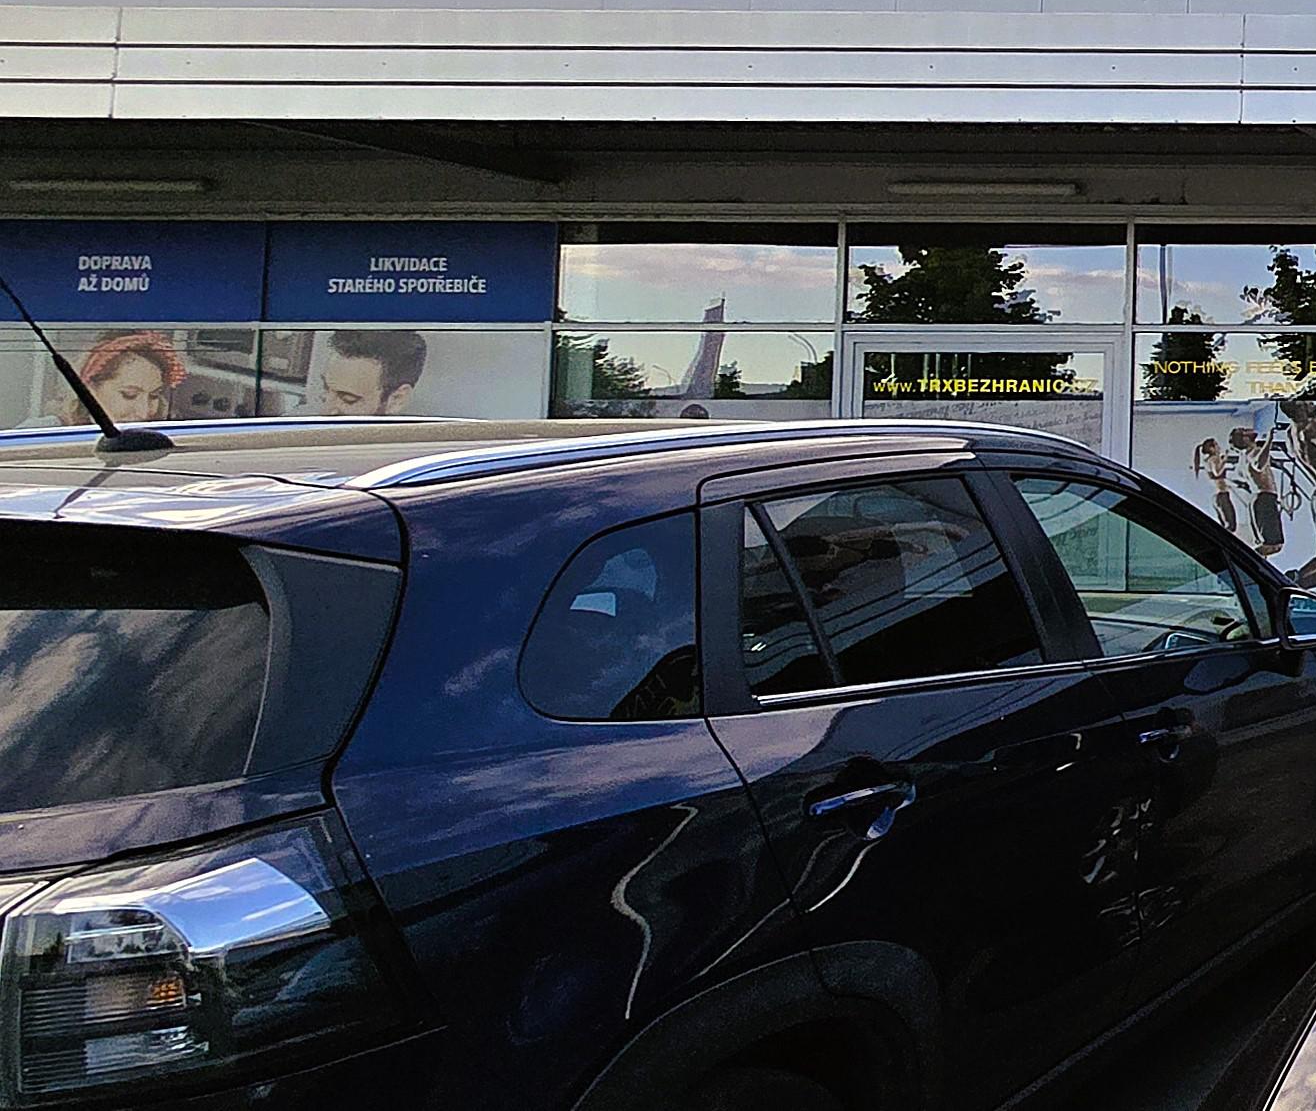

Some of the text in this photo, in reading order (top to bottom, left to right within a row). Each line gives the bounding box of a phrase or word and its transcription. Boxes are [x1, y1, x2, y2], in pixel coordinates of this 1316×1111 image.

[78, 255, 152, 270] DOPRAVA
[369, 257, 447, 272] LIKVIDACE
[78, 272, 149, 291] AŽ DOMŮ
[328, 275, 486, 293] STARÉHO SPOTŘEBIČE
[1154, 361, 1240, 375] NOTHING
